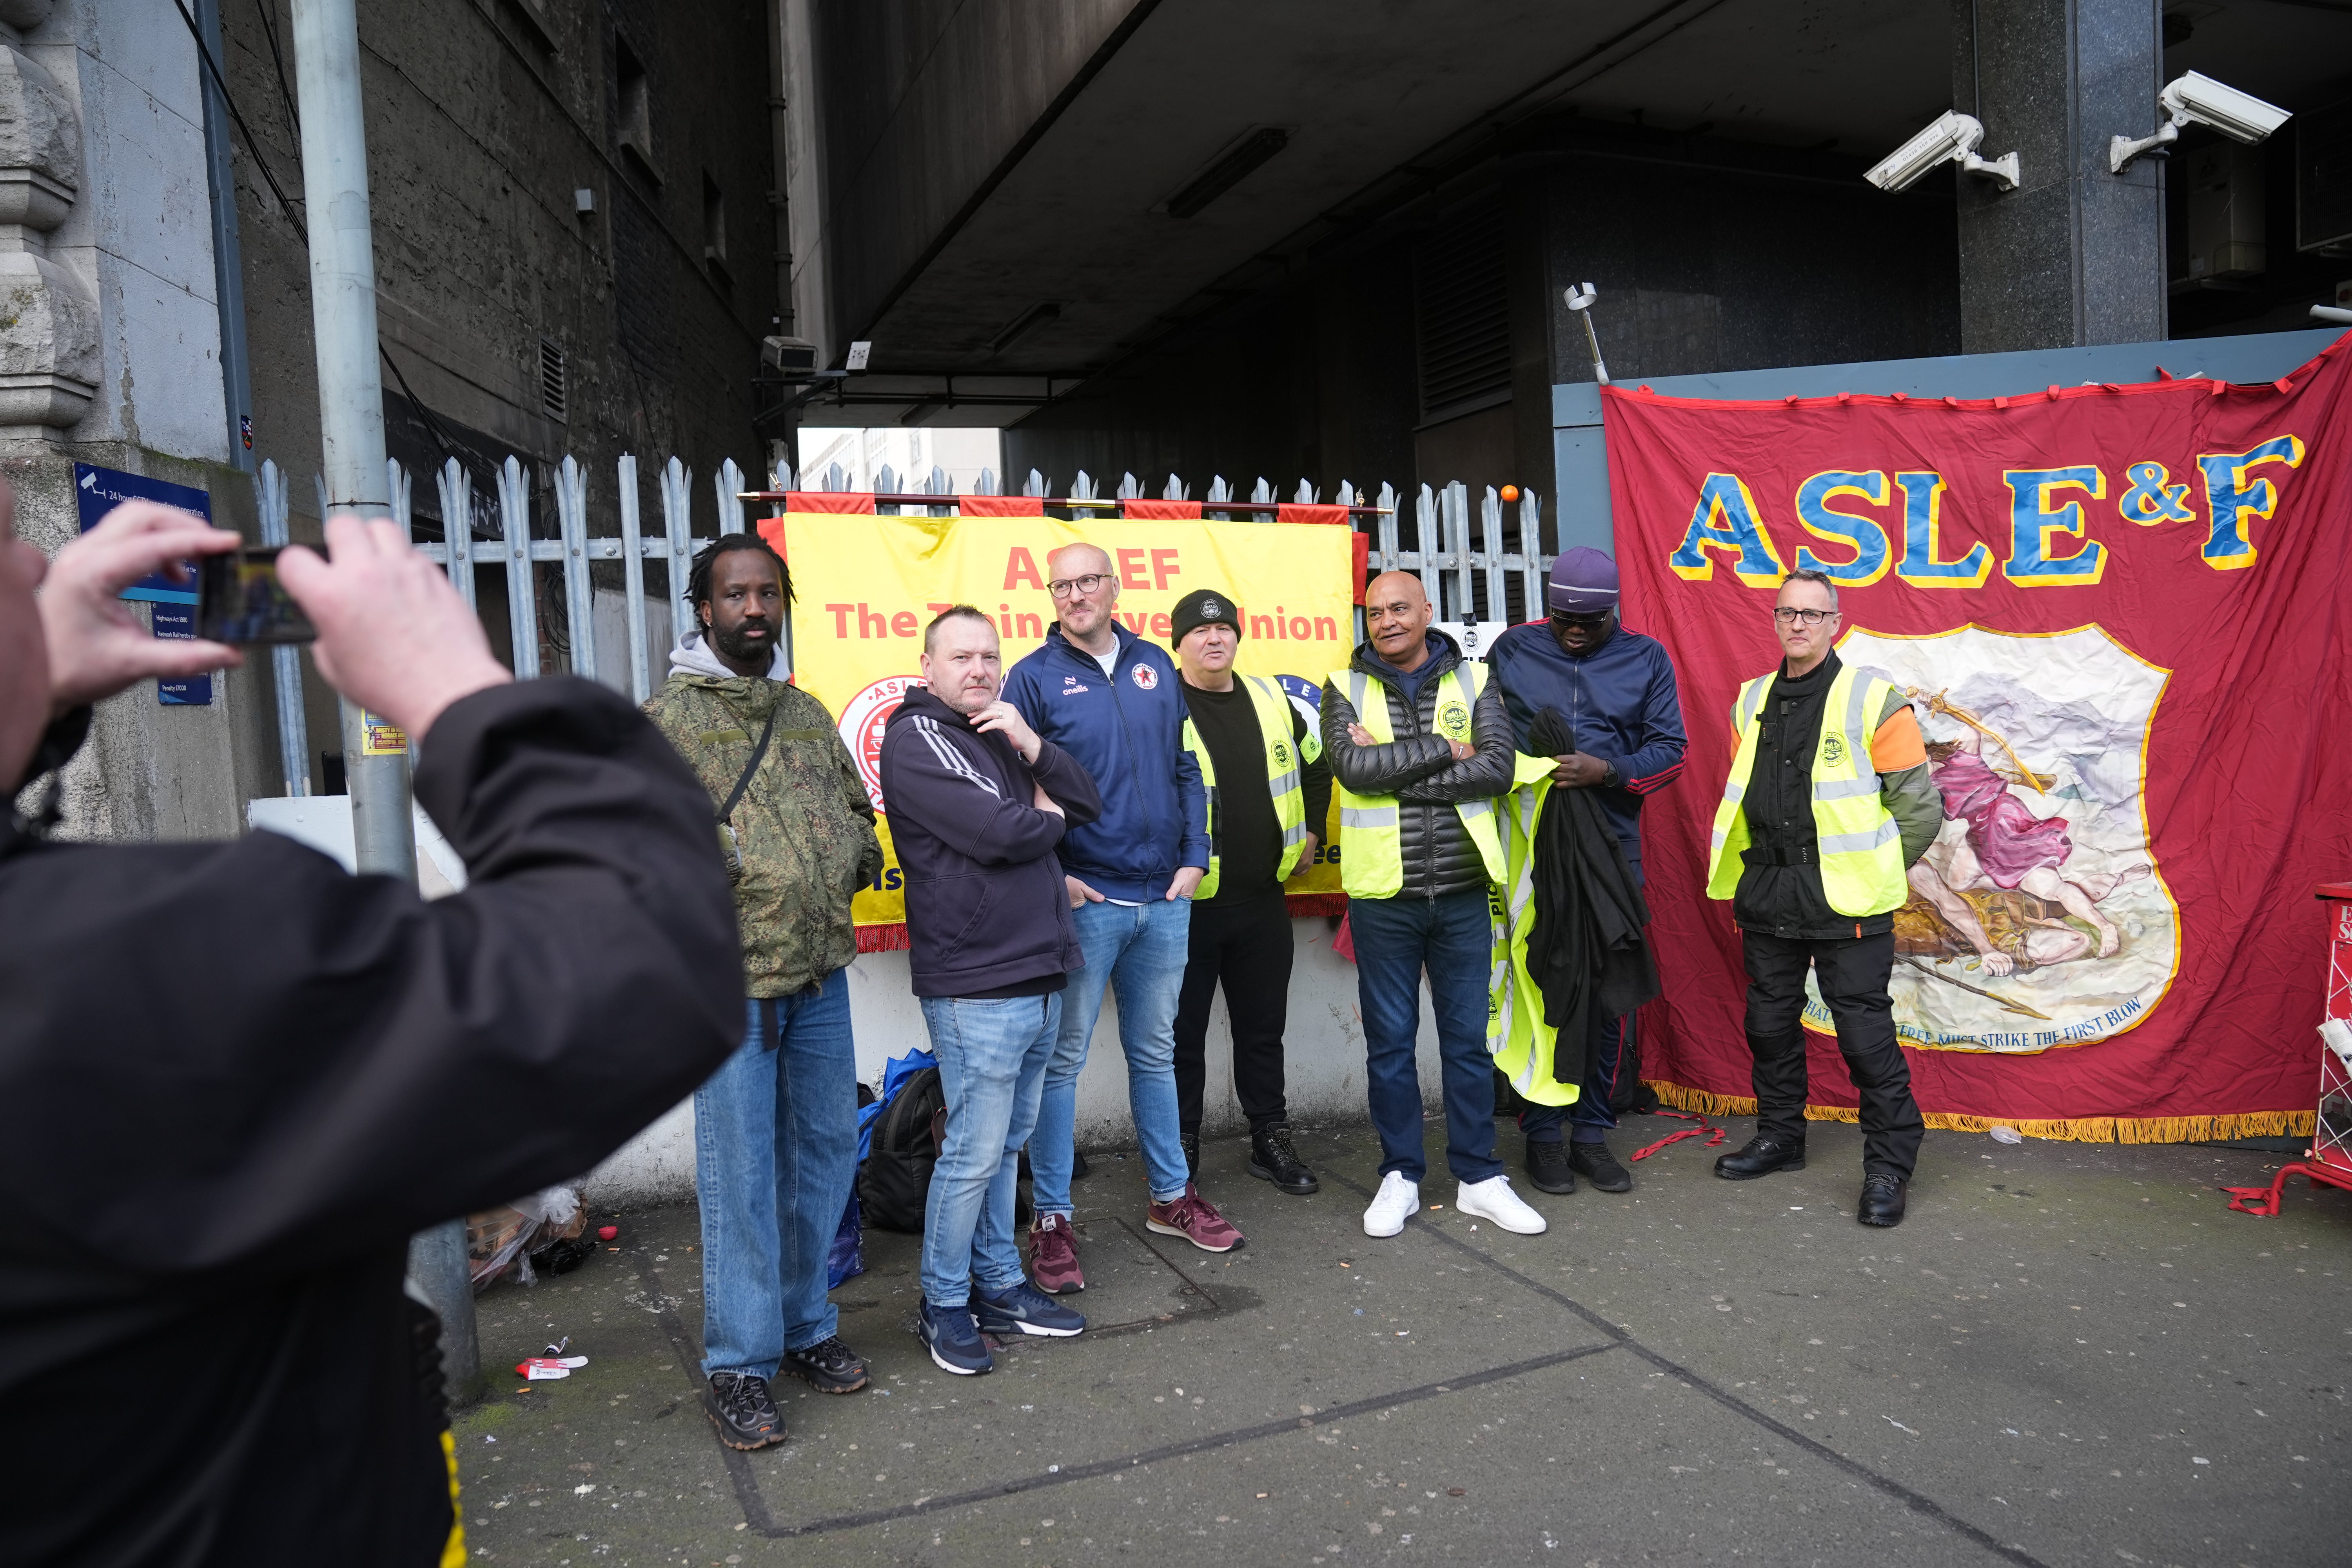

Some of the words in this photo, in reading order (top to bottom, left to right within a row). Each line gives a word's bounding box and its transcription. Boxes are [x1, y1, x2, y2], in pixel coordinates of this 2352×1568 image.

[1903, 149, 1918, 161] 01438
[1929, 133, 1939, 142] 996
[1923, 130, 1937, 140] Services
[109, 490, 118, 501] 24
[118, 492, 132, 503] hour
[133, 495, 149, 504] CCTV
[149, 500, 174, 511] recording
[181, 507, 205, 518] operation.
[1003, 547, 1180, 590] AEF
[825, 603, 918, 639] The
[927, 603, 1043, 638] Tin
[875, 680, 927, 701] ASLE
[1804, 1000, 1831, 1022] HAT
[1938, 1033, 1976, 1045] MUST
[1981, 1033, 2030, 1046] STRIKE
[2033, 1030, 2060, 1045] THE
[2063, 1017, 2104, 1040] FIRST
[2104, 996, 2141, 1027] BLOW
